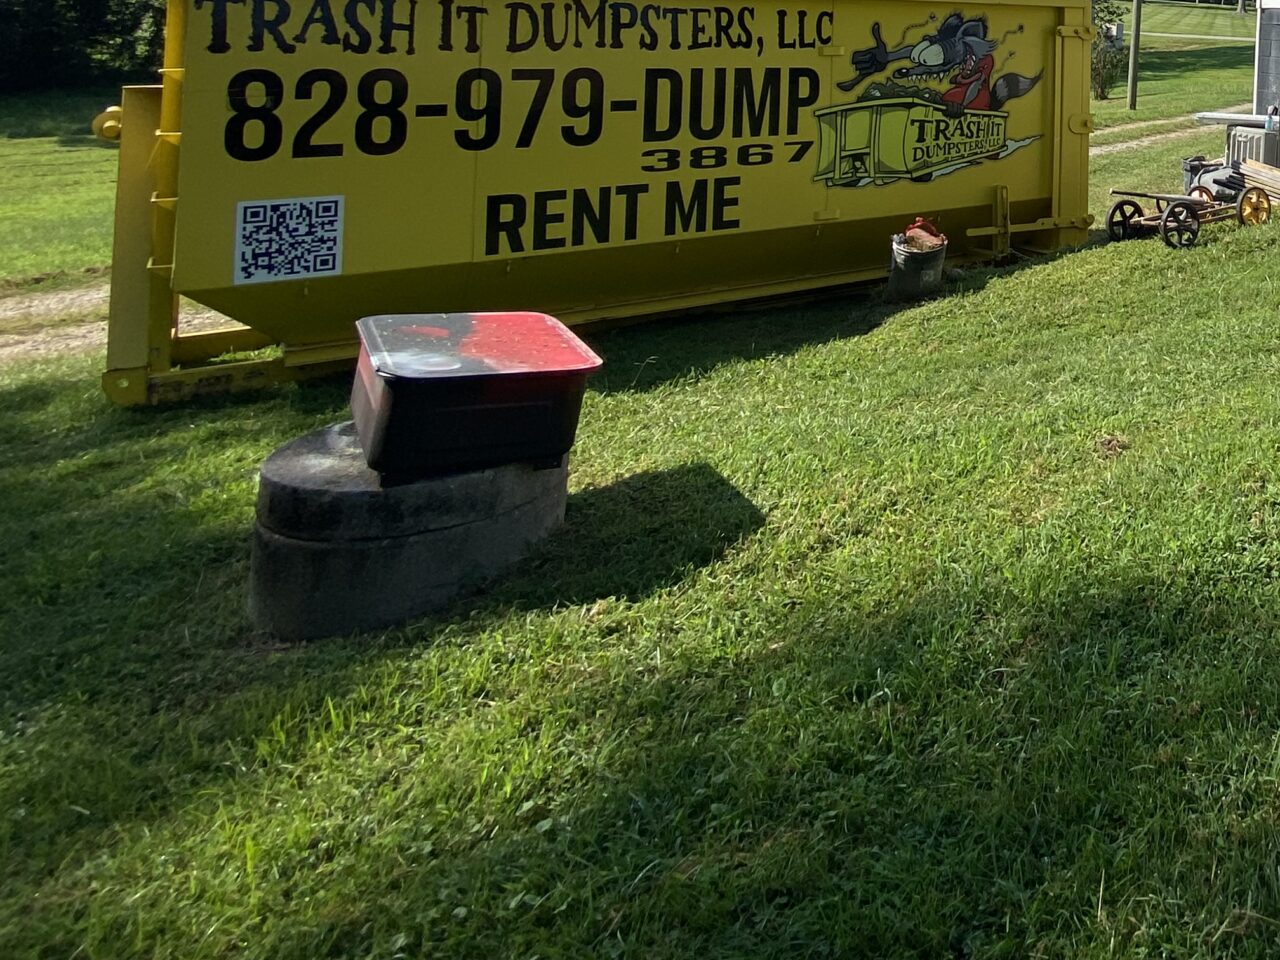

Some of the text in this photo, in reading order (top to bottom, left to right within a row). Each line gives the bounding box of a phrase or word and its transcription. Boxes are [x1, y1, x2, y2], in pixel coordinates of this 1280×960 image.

[777, 9, 834, 50] LLC
[224, 67, 821, 162] 828-979-DUMP
[910, 119, 1002, 144] TRASH IT
[640, 141, 815, 173] 3867
[988, 137, 1000, 147] LLC
[484, 175, 742, 256] RENT ME
